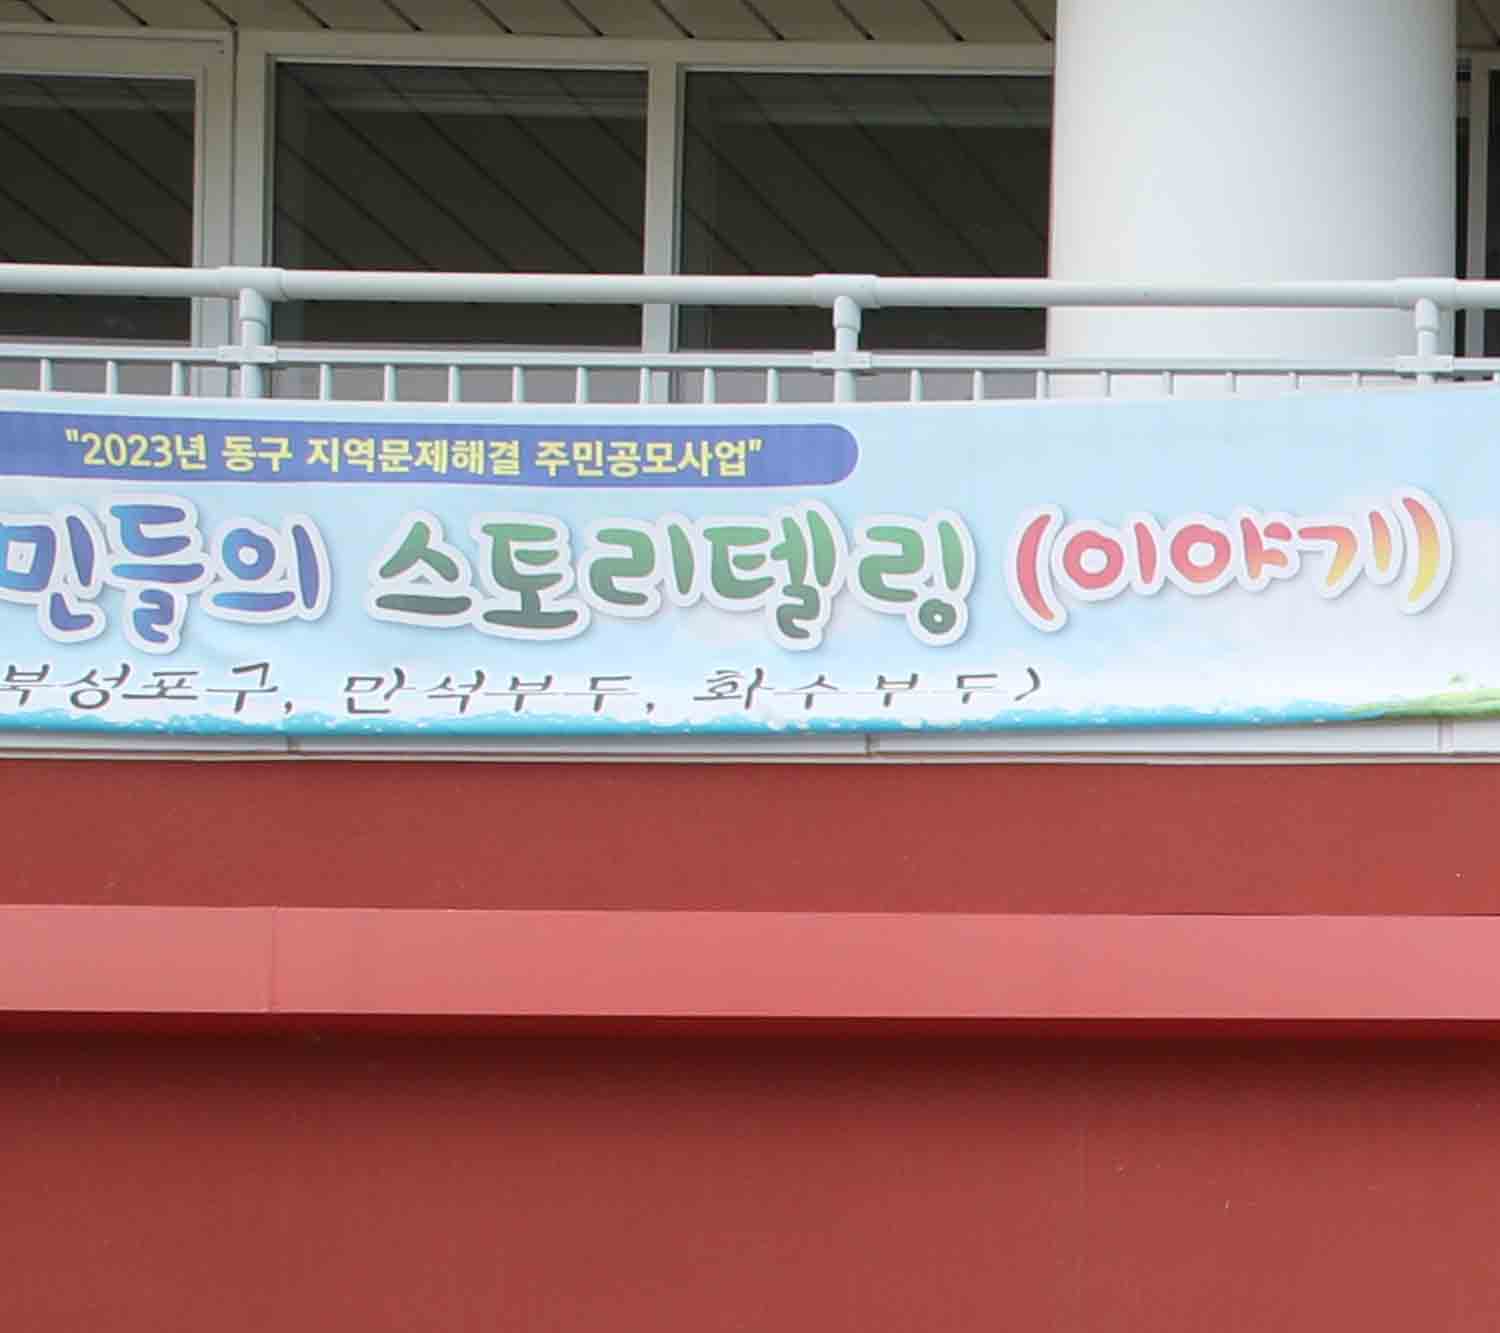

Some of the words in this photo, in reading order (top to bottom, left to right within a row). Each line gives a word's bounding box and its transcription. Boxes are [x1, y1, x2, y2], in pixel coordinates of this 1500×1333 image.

[65, 427, 208, 470] "2023년
[221, 435, 293, 473] 동구
[305, 436, 521, 475] 지역문제해결
[534, 438, 763, 478] 주민공모사업"
[0, 502, 323, 644] 민들의
[374, 509, 968, 640] 스토리텔링
[1015, 495, 1442, 622] (이야기)
